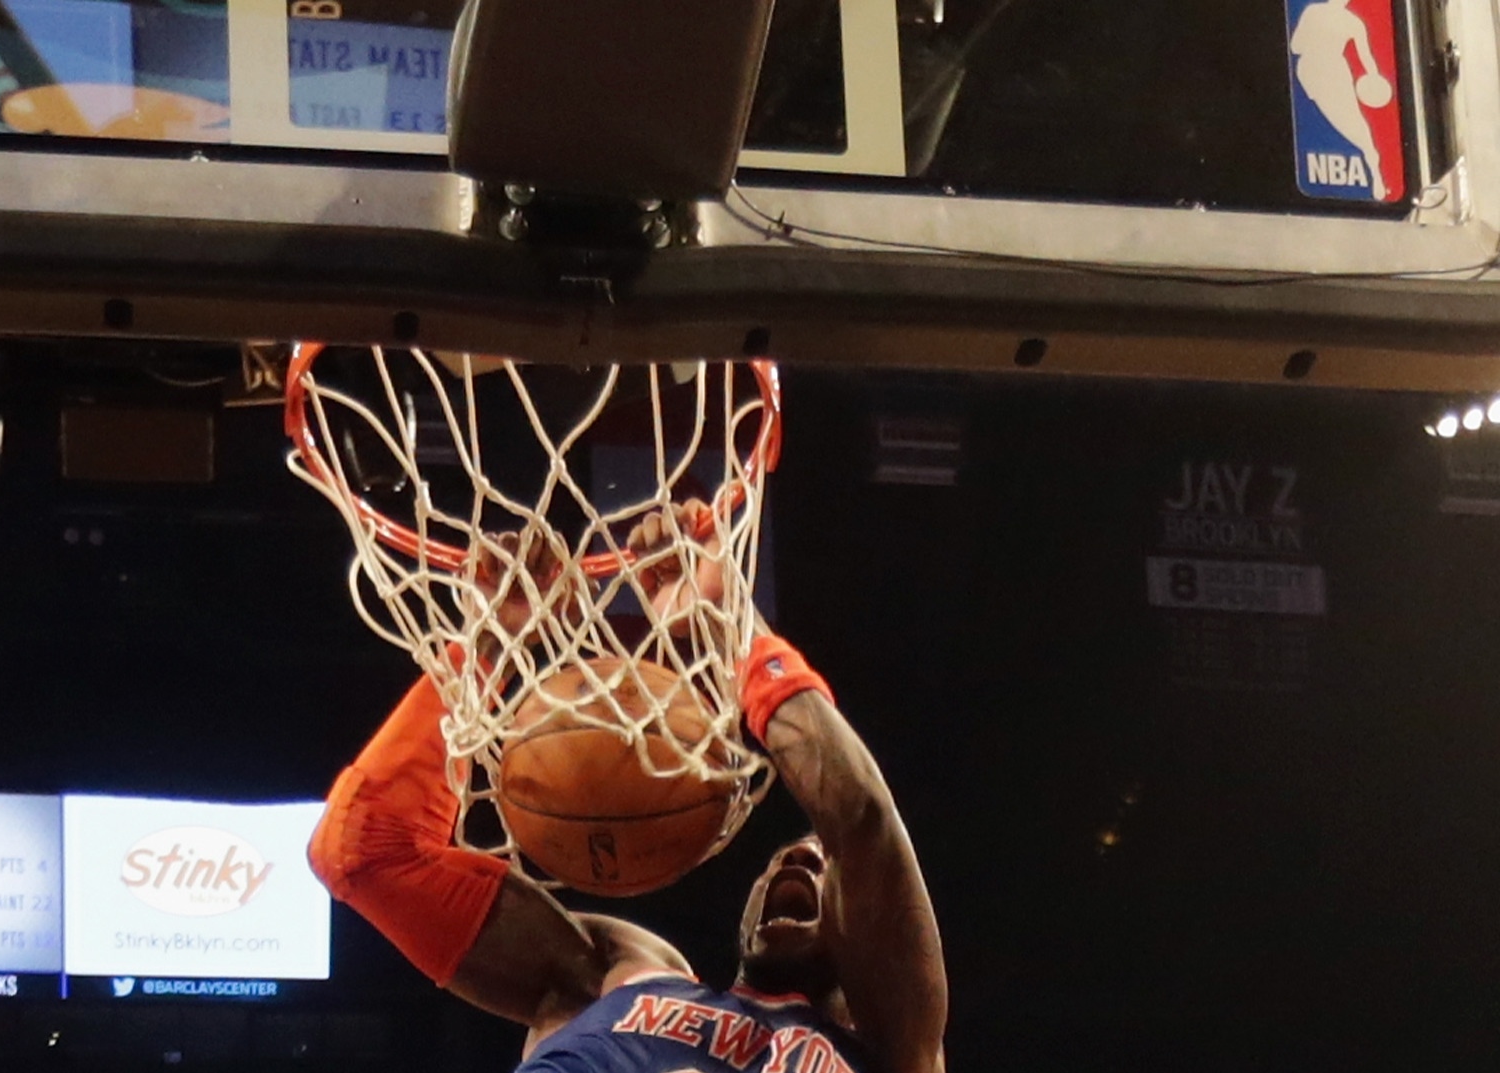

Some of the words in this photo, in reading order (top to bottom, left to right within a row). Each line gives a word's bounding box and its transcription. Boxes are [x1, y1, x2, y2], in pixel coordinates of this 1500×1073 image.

[1307, 153, 1368, 187] NBA
[1164, 461, 1252, 515] JAY
[1271, 466, 1299, 517] Z
[0, 857, 25, 874] PTS
[120, 844, 274, 907] Stinky
[1, 931, 26, 948] PTS
[114, 931, 280, 954] StinkyBklyn.com
[143, 979, 278, 996] @BARCLAYSCENTER
[612, 994, 773, 1070] NEW
